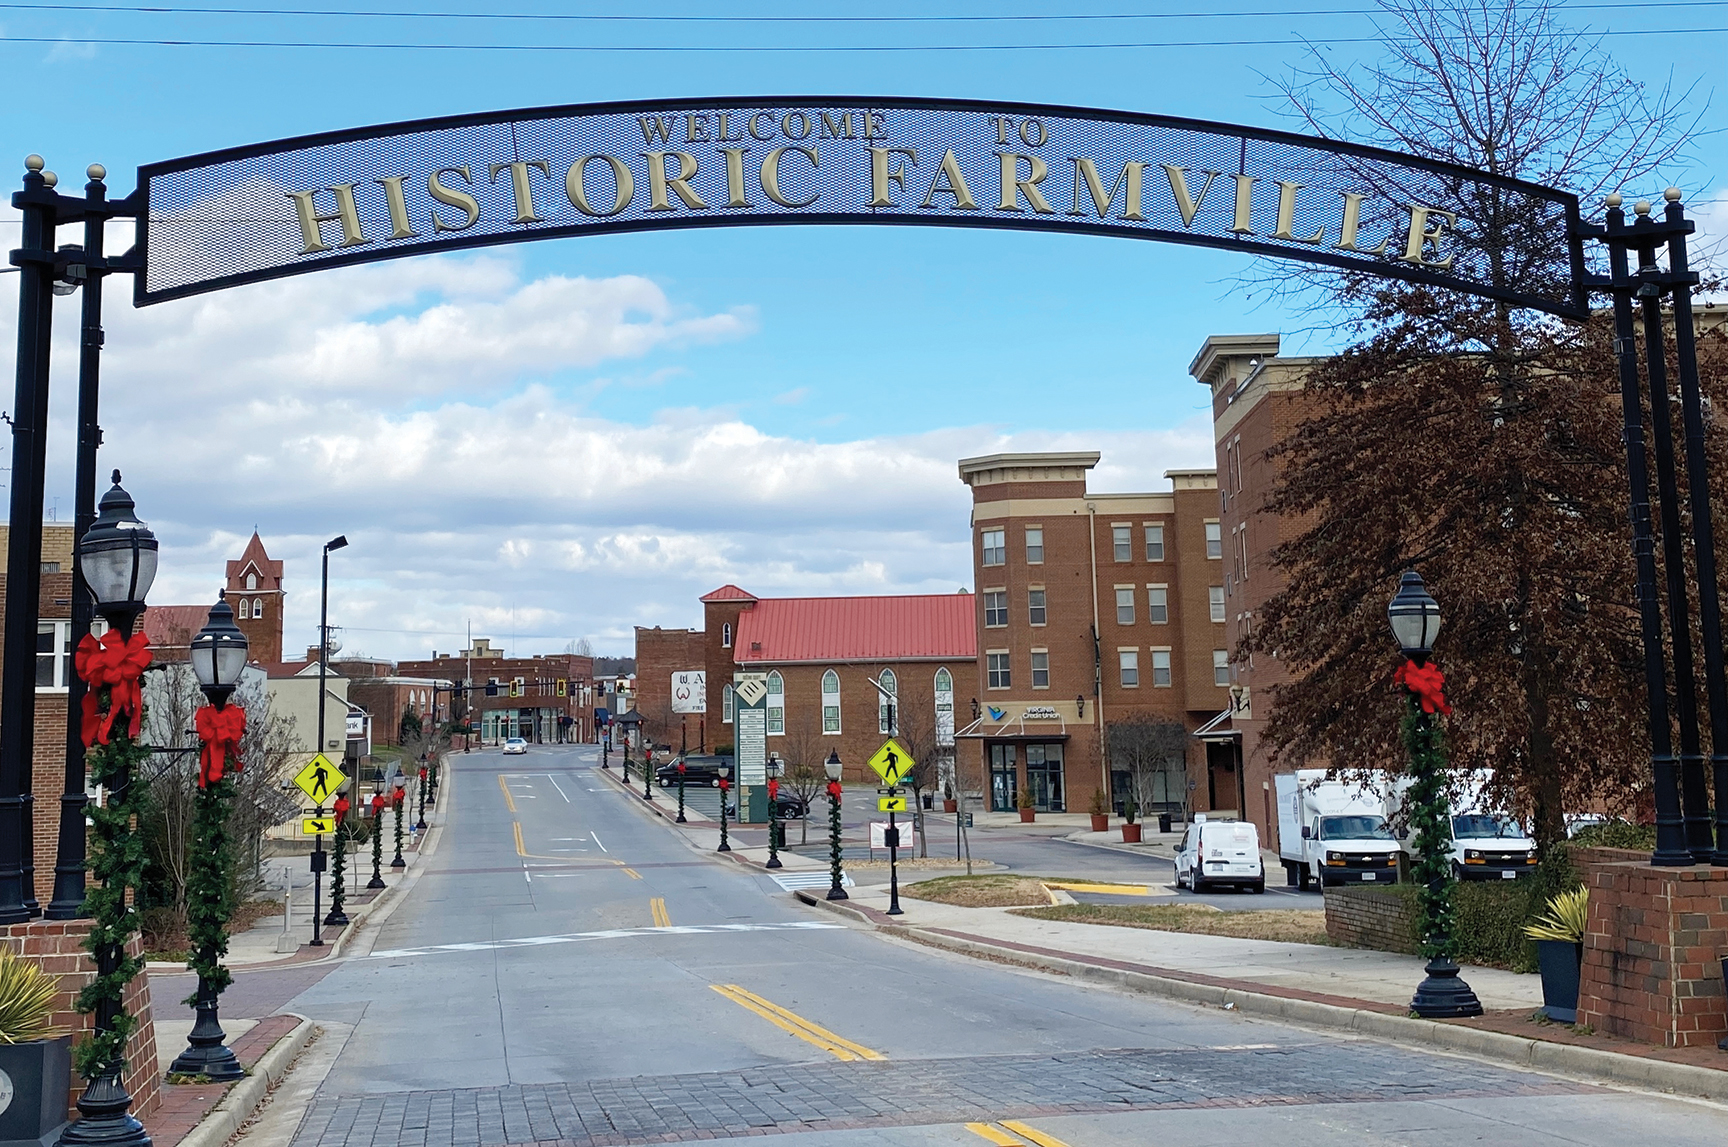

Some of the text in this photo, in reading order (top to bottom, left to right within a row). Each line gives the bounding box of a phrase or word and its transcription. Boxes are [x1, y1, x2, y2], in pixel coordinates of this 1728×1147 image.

[637, 112, 1049, 148] WELCOME TO
[285, 145, 1457, 270] HISTORIC FARMVILLE
